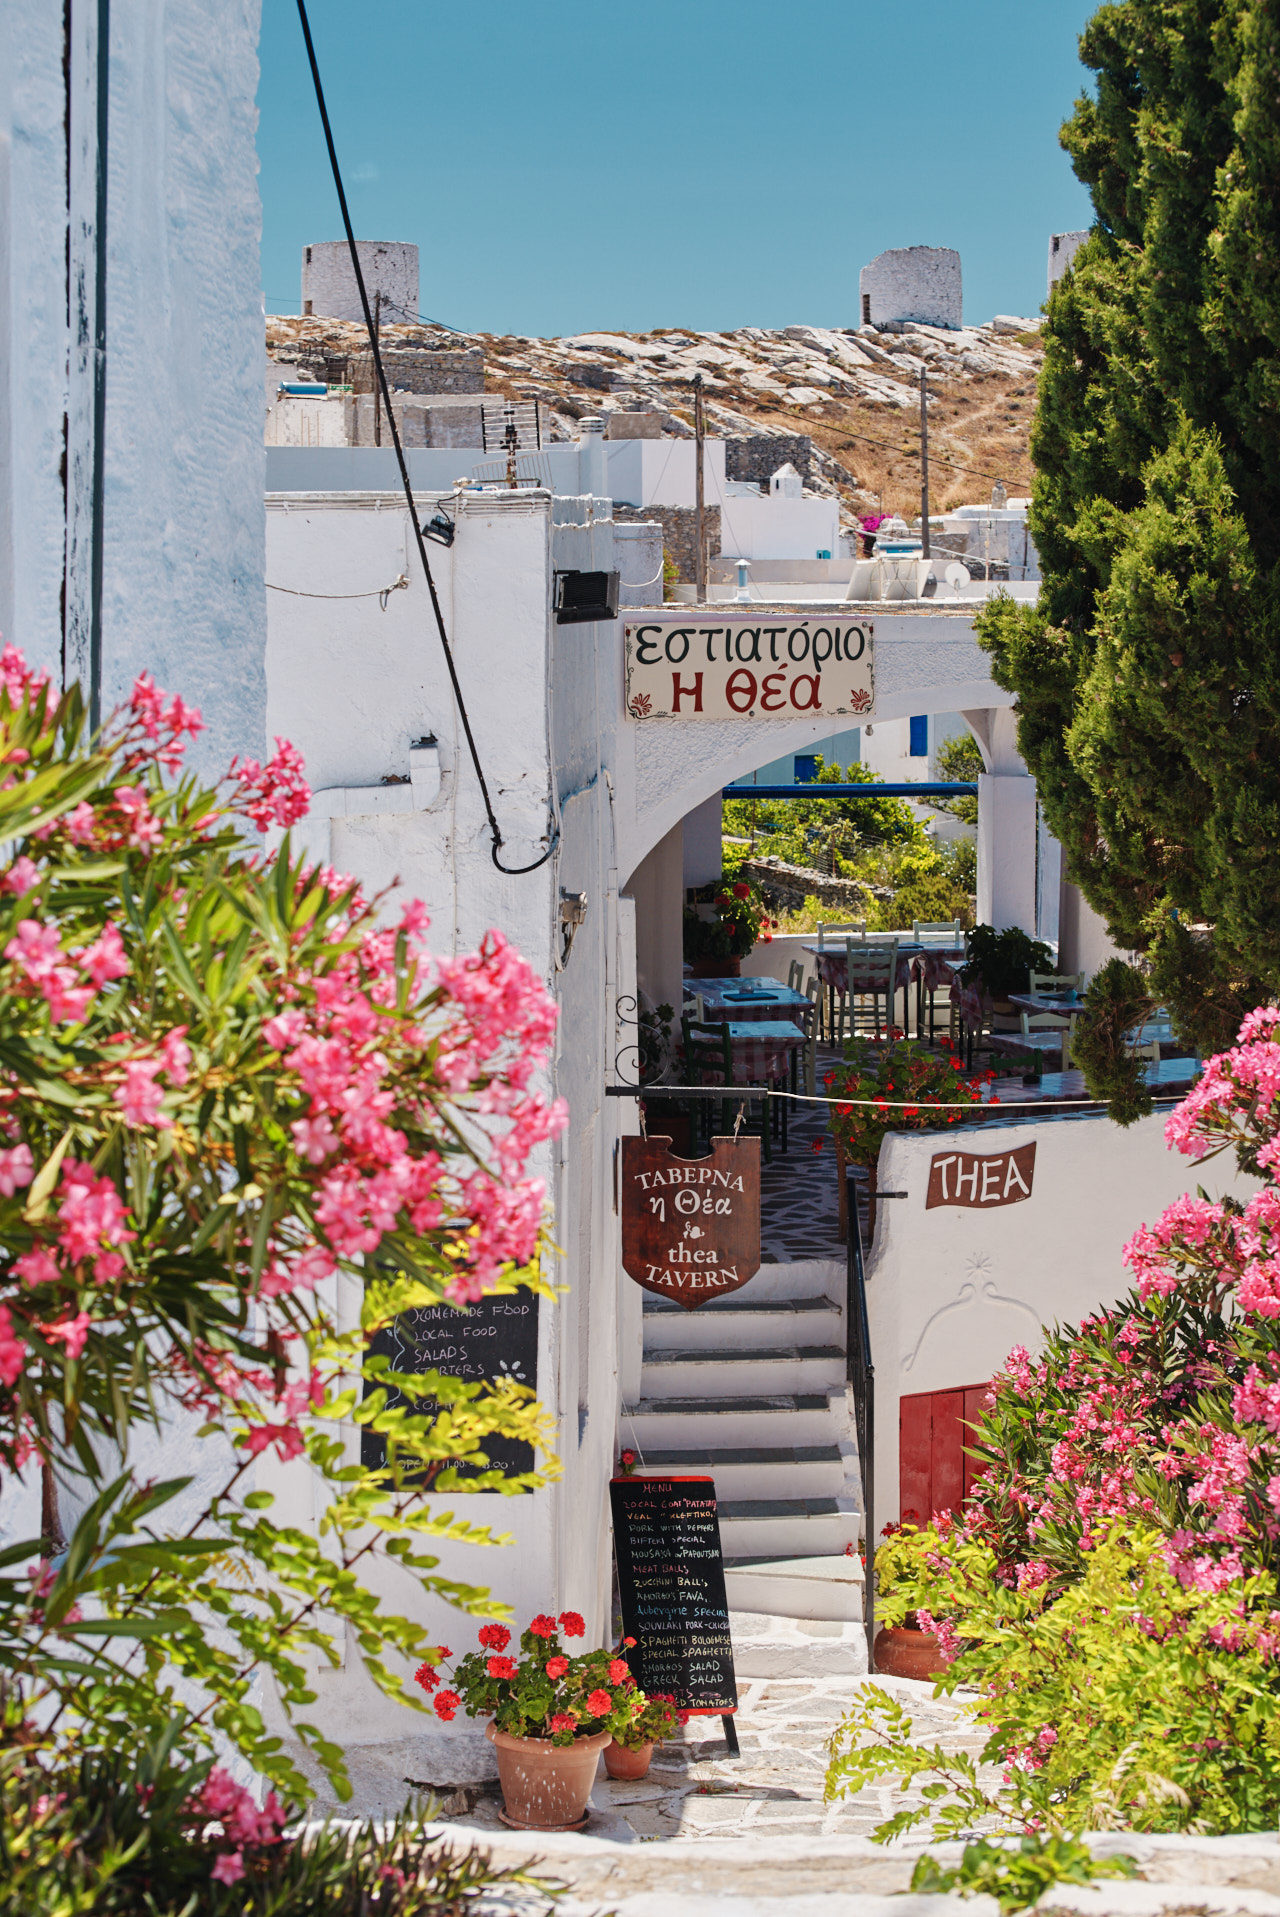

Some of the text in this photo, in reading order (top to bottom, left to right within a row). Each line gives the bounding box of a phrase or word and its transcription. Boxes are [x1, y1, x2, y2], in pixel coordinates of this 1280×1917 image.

[634, 1167, 745, 1193] ΤΑΒΕΡΝΑ
[933, 1155, 1030, 1202] THEA
[649, 1188, 732, 1223] η Θέα
[668, 1242, 719, 1264] thea
[645, 1263, 739, 1288] TAVERN
[412, 1307, 484, 1324] HOMEMADE
[415, 1326, 497, 1341] LOCAL FOOD
[414, 1345, 469, 1363] SALADS
[413, 1364, 485, 1376] STRTERS
[643, 1483, 672, 1494] MENU
[628, 1524, 654, 1532] PORK
[672, 1535, 706, 1544] SPECIAL
[633, 1564, 690, 1575] MEAT BALLS
[694, 1607, 729, 1618] SPECIAL
[638, 1621, 682, 1632] SOUVLAKI
[640, 1636, 688, 1648] SPAGHETTI
[642, 1647, 732, 1661] SPECIAL SPAGHETTI
[689, 1660, 721, 1672] SALAD
[689, 1673, 724, 1686] SALAD
